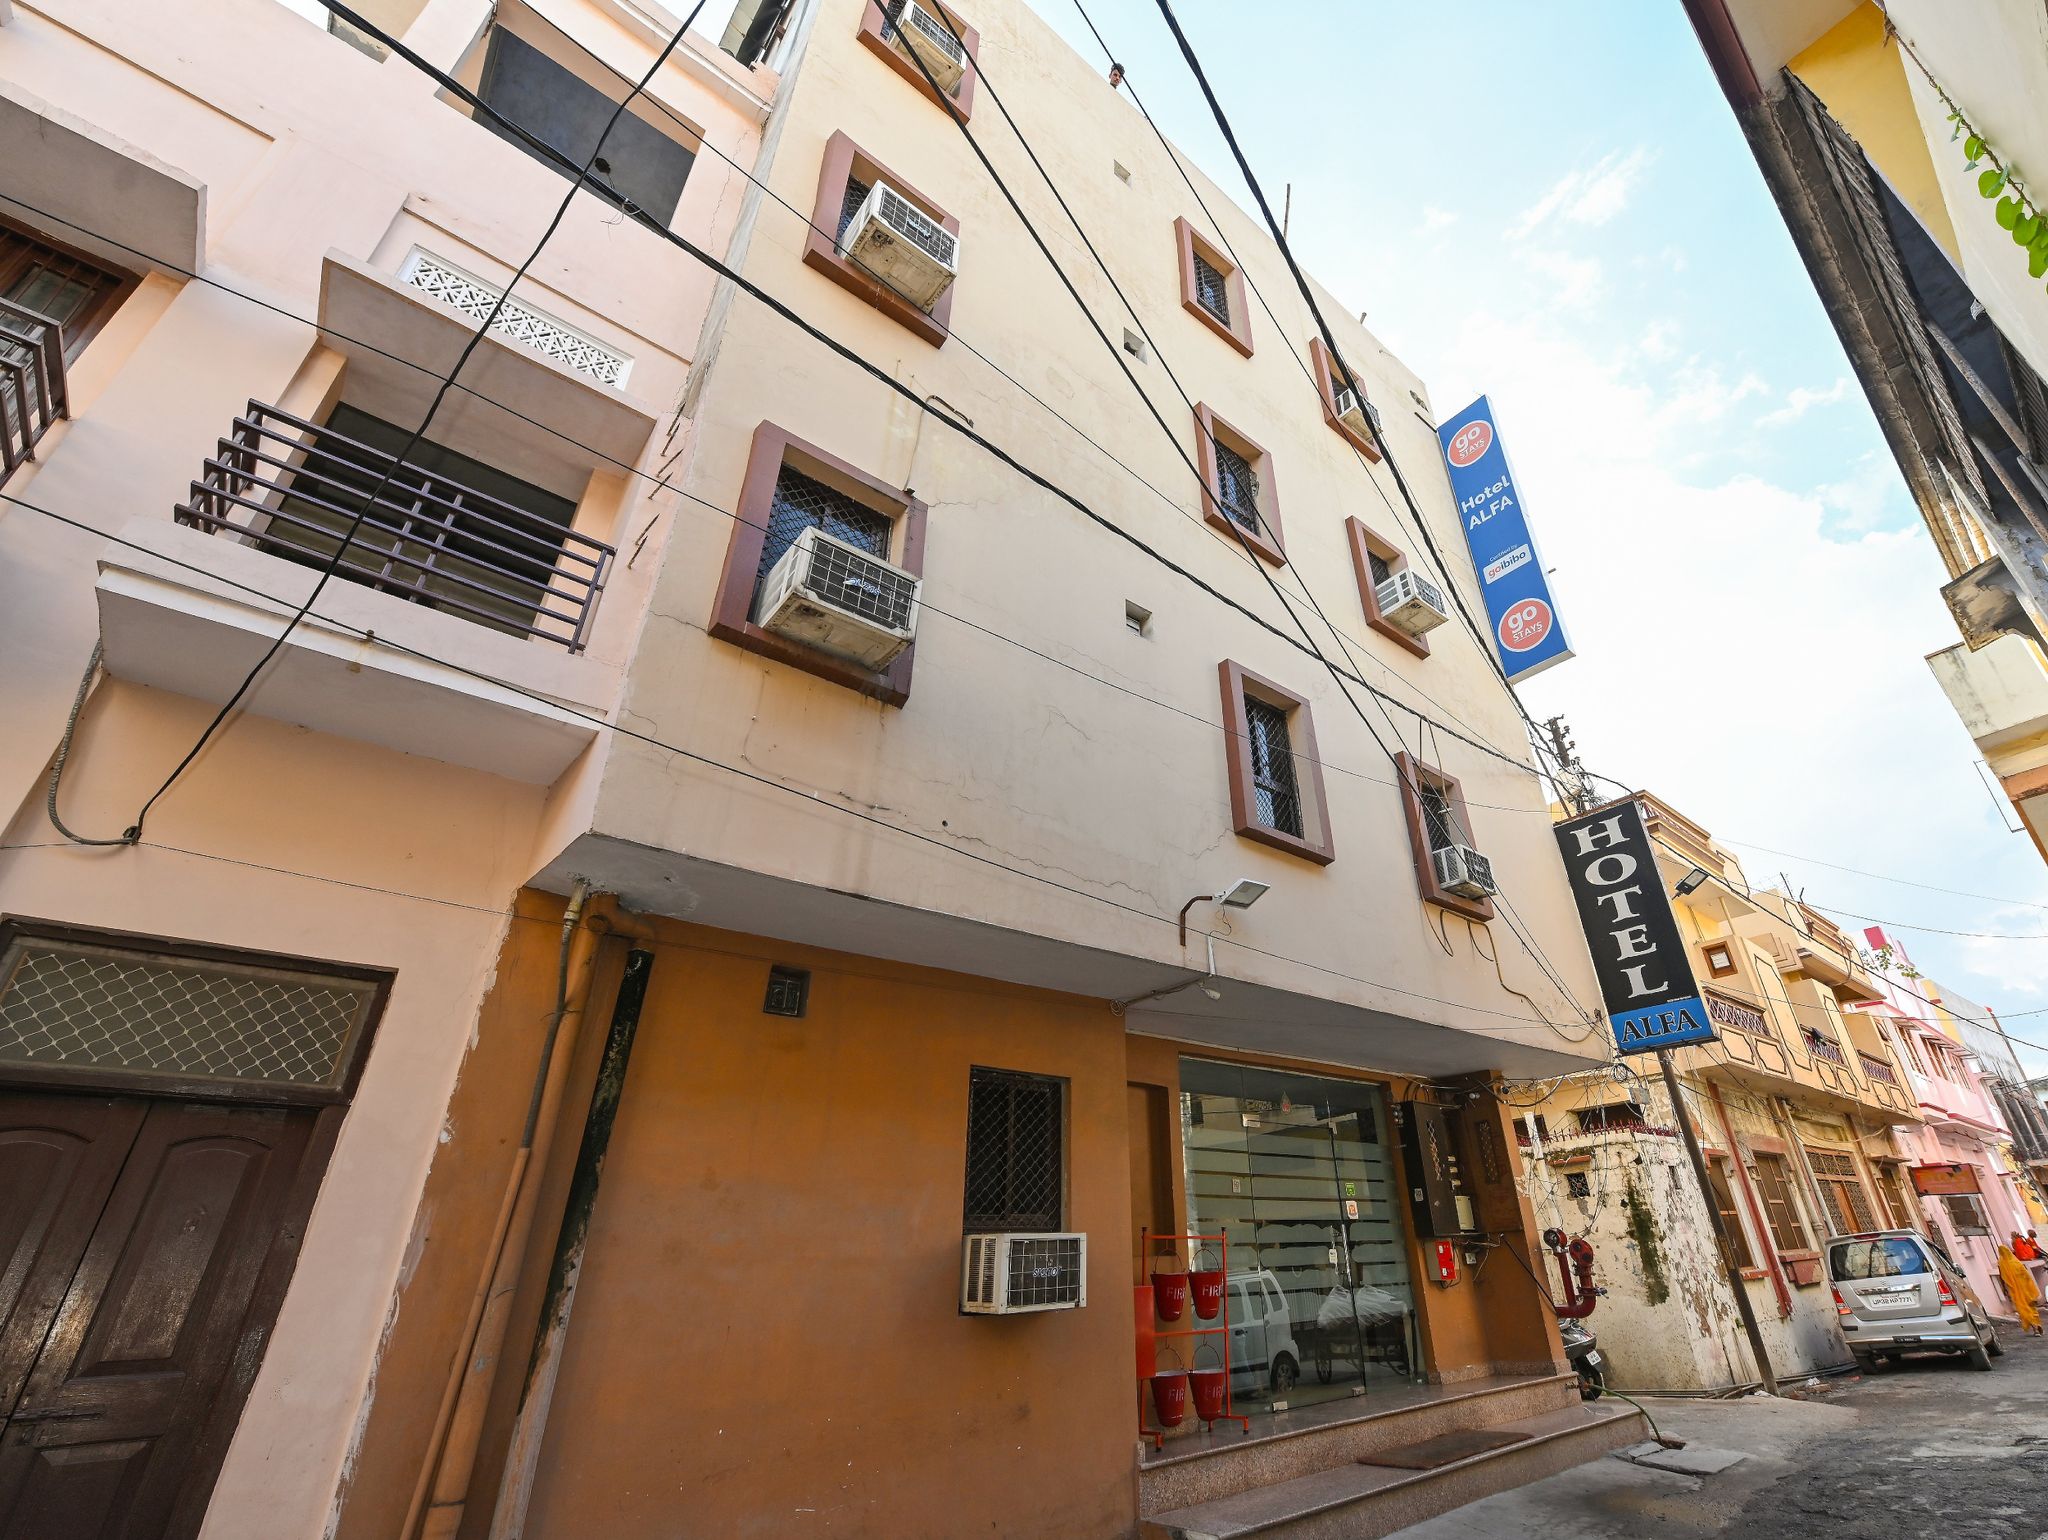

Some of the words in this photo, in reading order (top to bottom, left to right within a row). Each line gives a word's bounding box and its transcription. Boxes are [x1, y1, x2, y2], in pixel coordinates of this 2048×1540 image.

[1456, 426, 1480, 452] go
[1459, 438, 1485, 459] STAYS
[1461, 475, 1510, 513] Hotel
[1469, 495, 1513, 530] ALFA
[1488, 551, 1526, 578] goibibo
[1508, 606, 1537, 633] go
[1512, 621, 1543, 641] STAYS
[1570, 814, 1669, 999] HOTEL
[1621, 1008, 1702, 1043] ALFA
